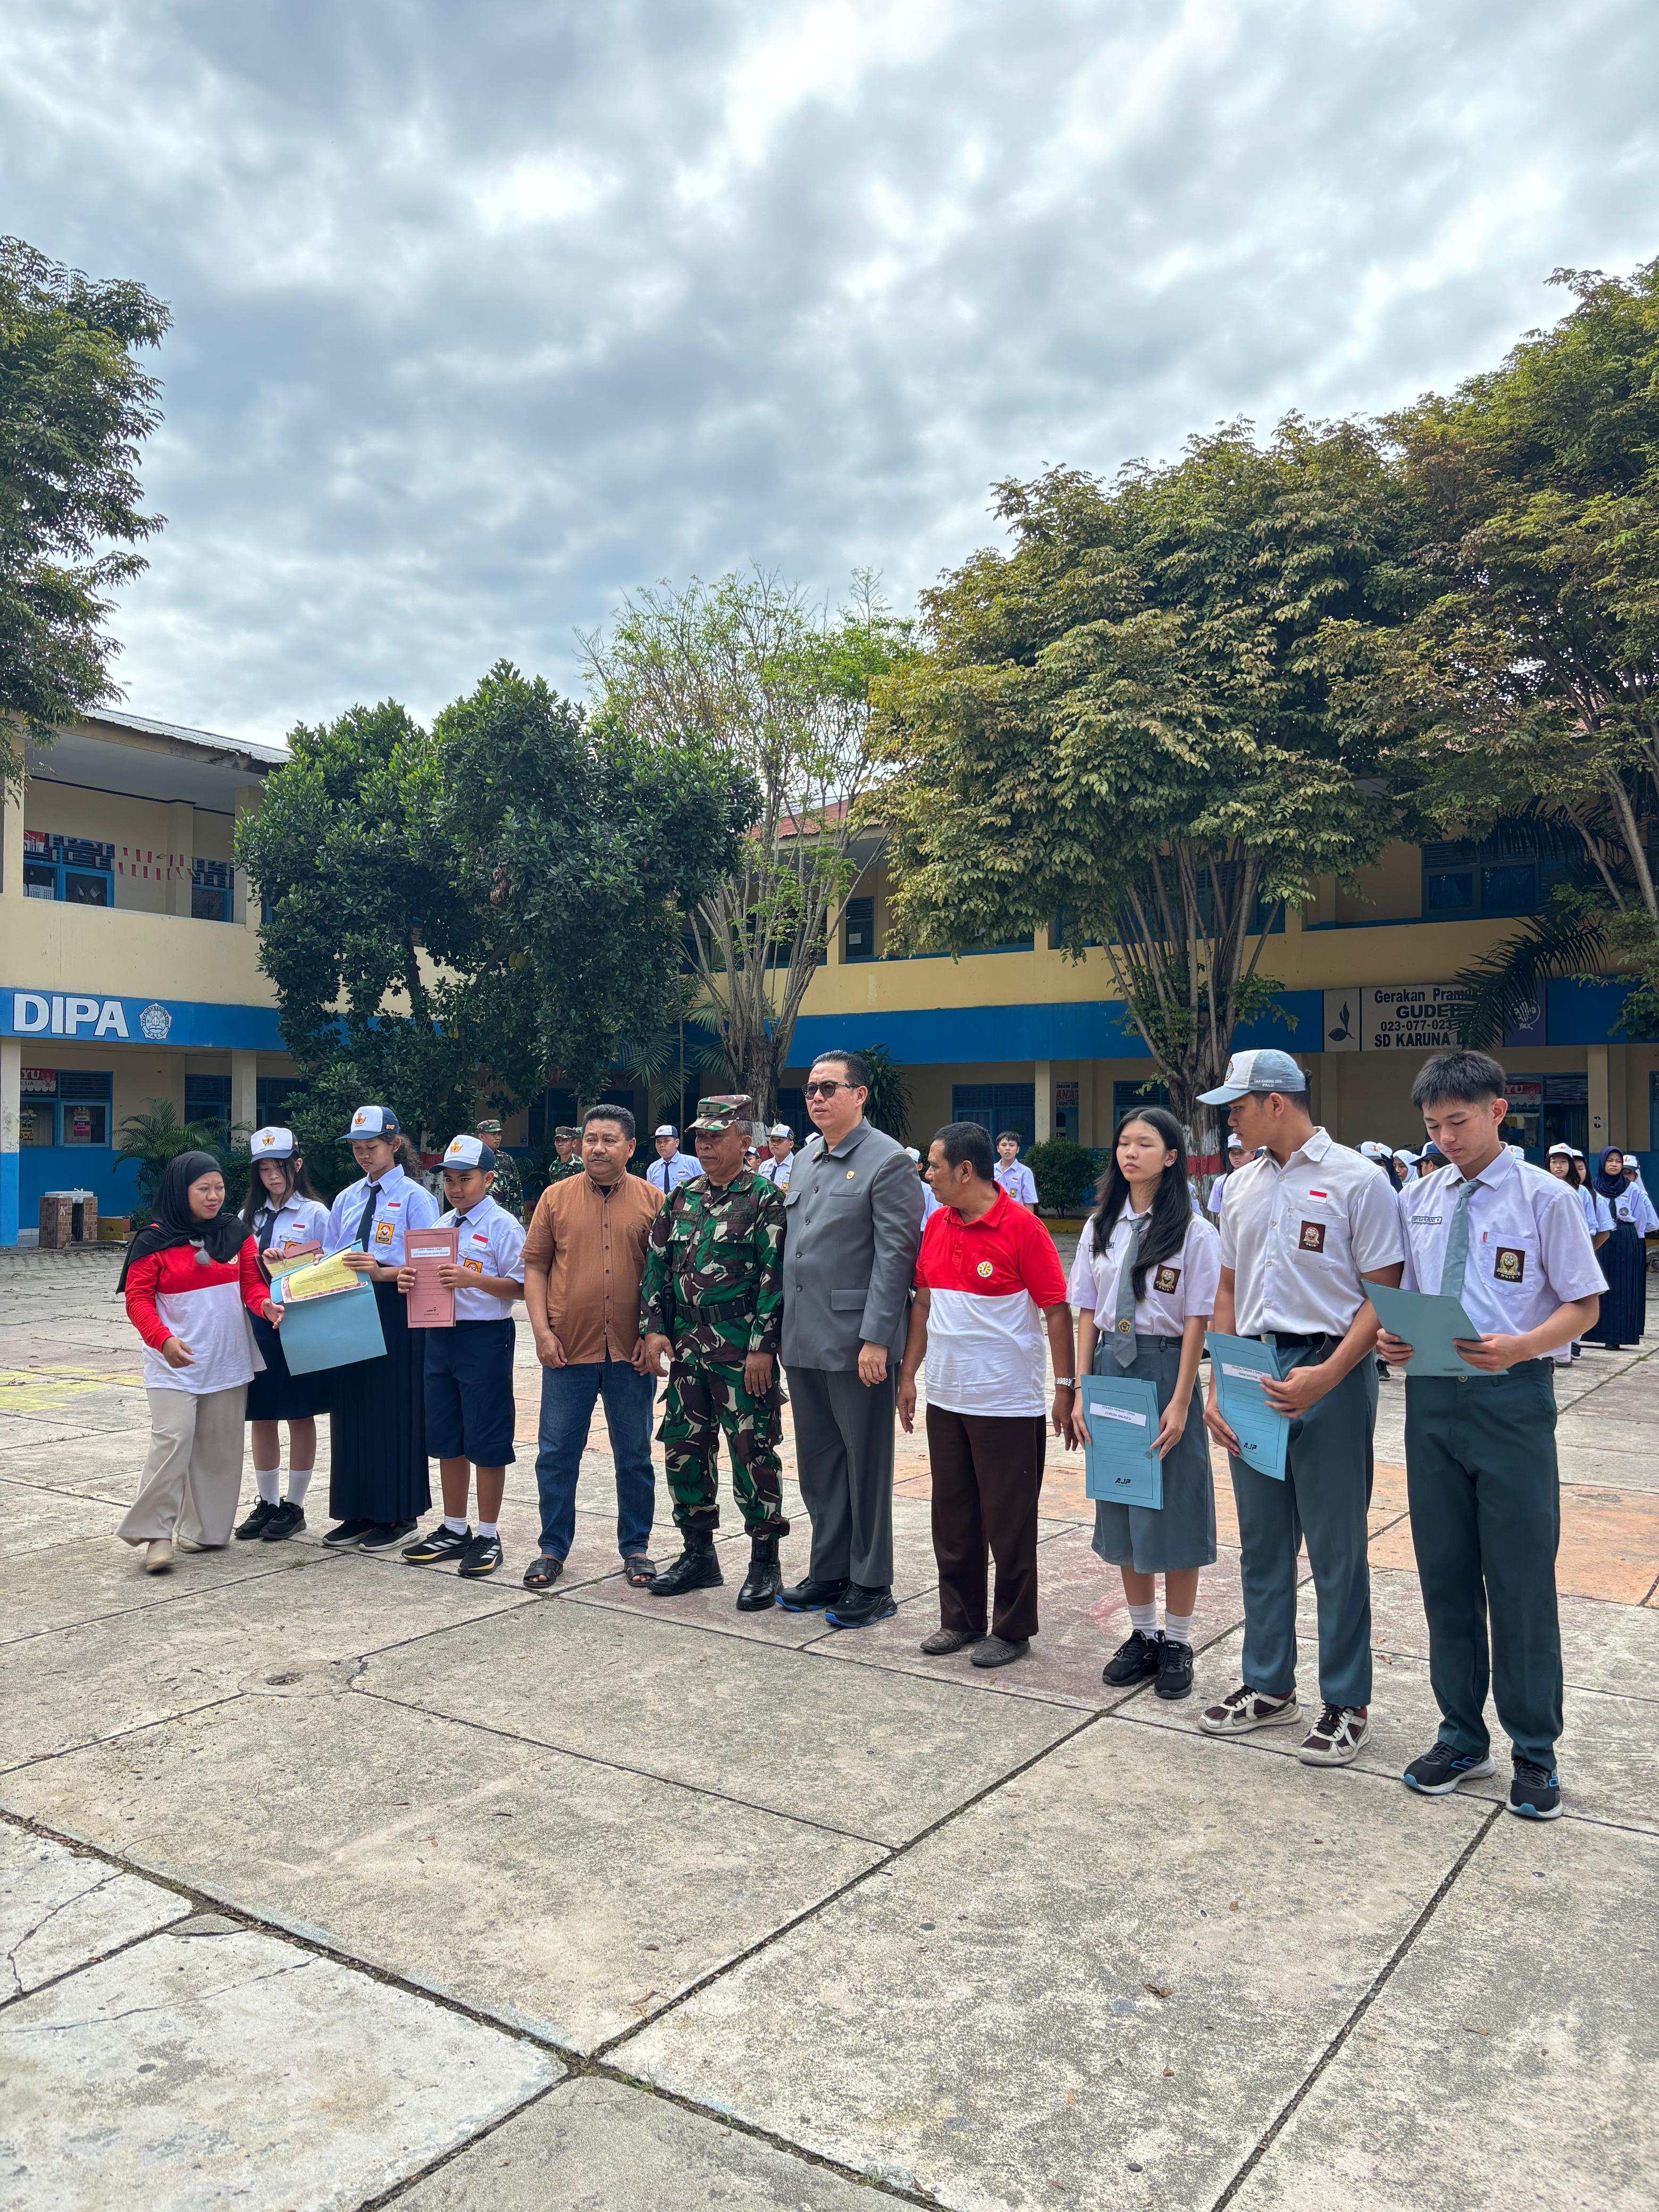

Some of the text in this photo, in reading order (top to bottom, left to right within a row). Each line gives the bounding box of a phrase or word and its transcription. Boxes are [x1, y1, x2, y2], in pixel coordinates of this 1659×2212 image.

[1375, 987, 1477, 1003] Gerakan Pram
[13, 992, 130, 1037] DIPA
[1375, 1034, 1391, 1047] SD
[1396, 1032, 1451, 1046] KARUNA
